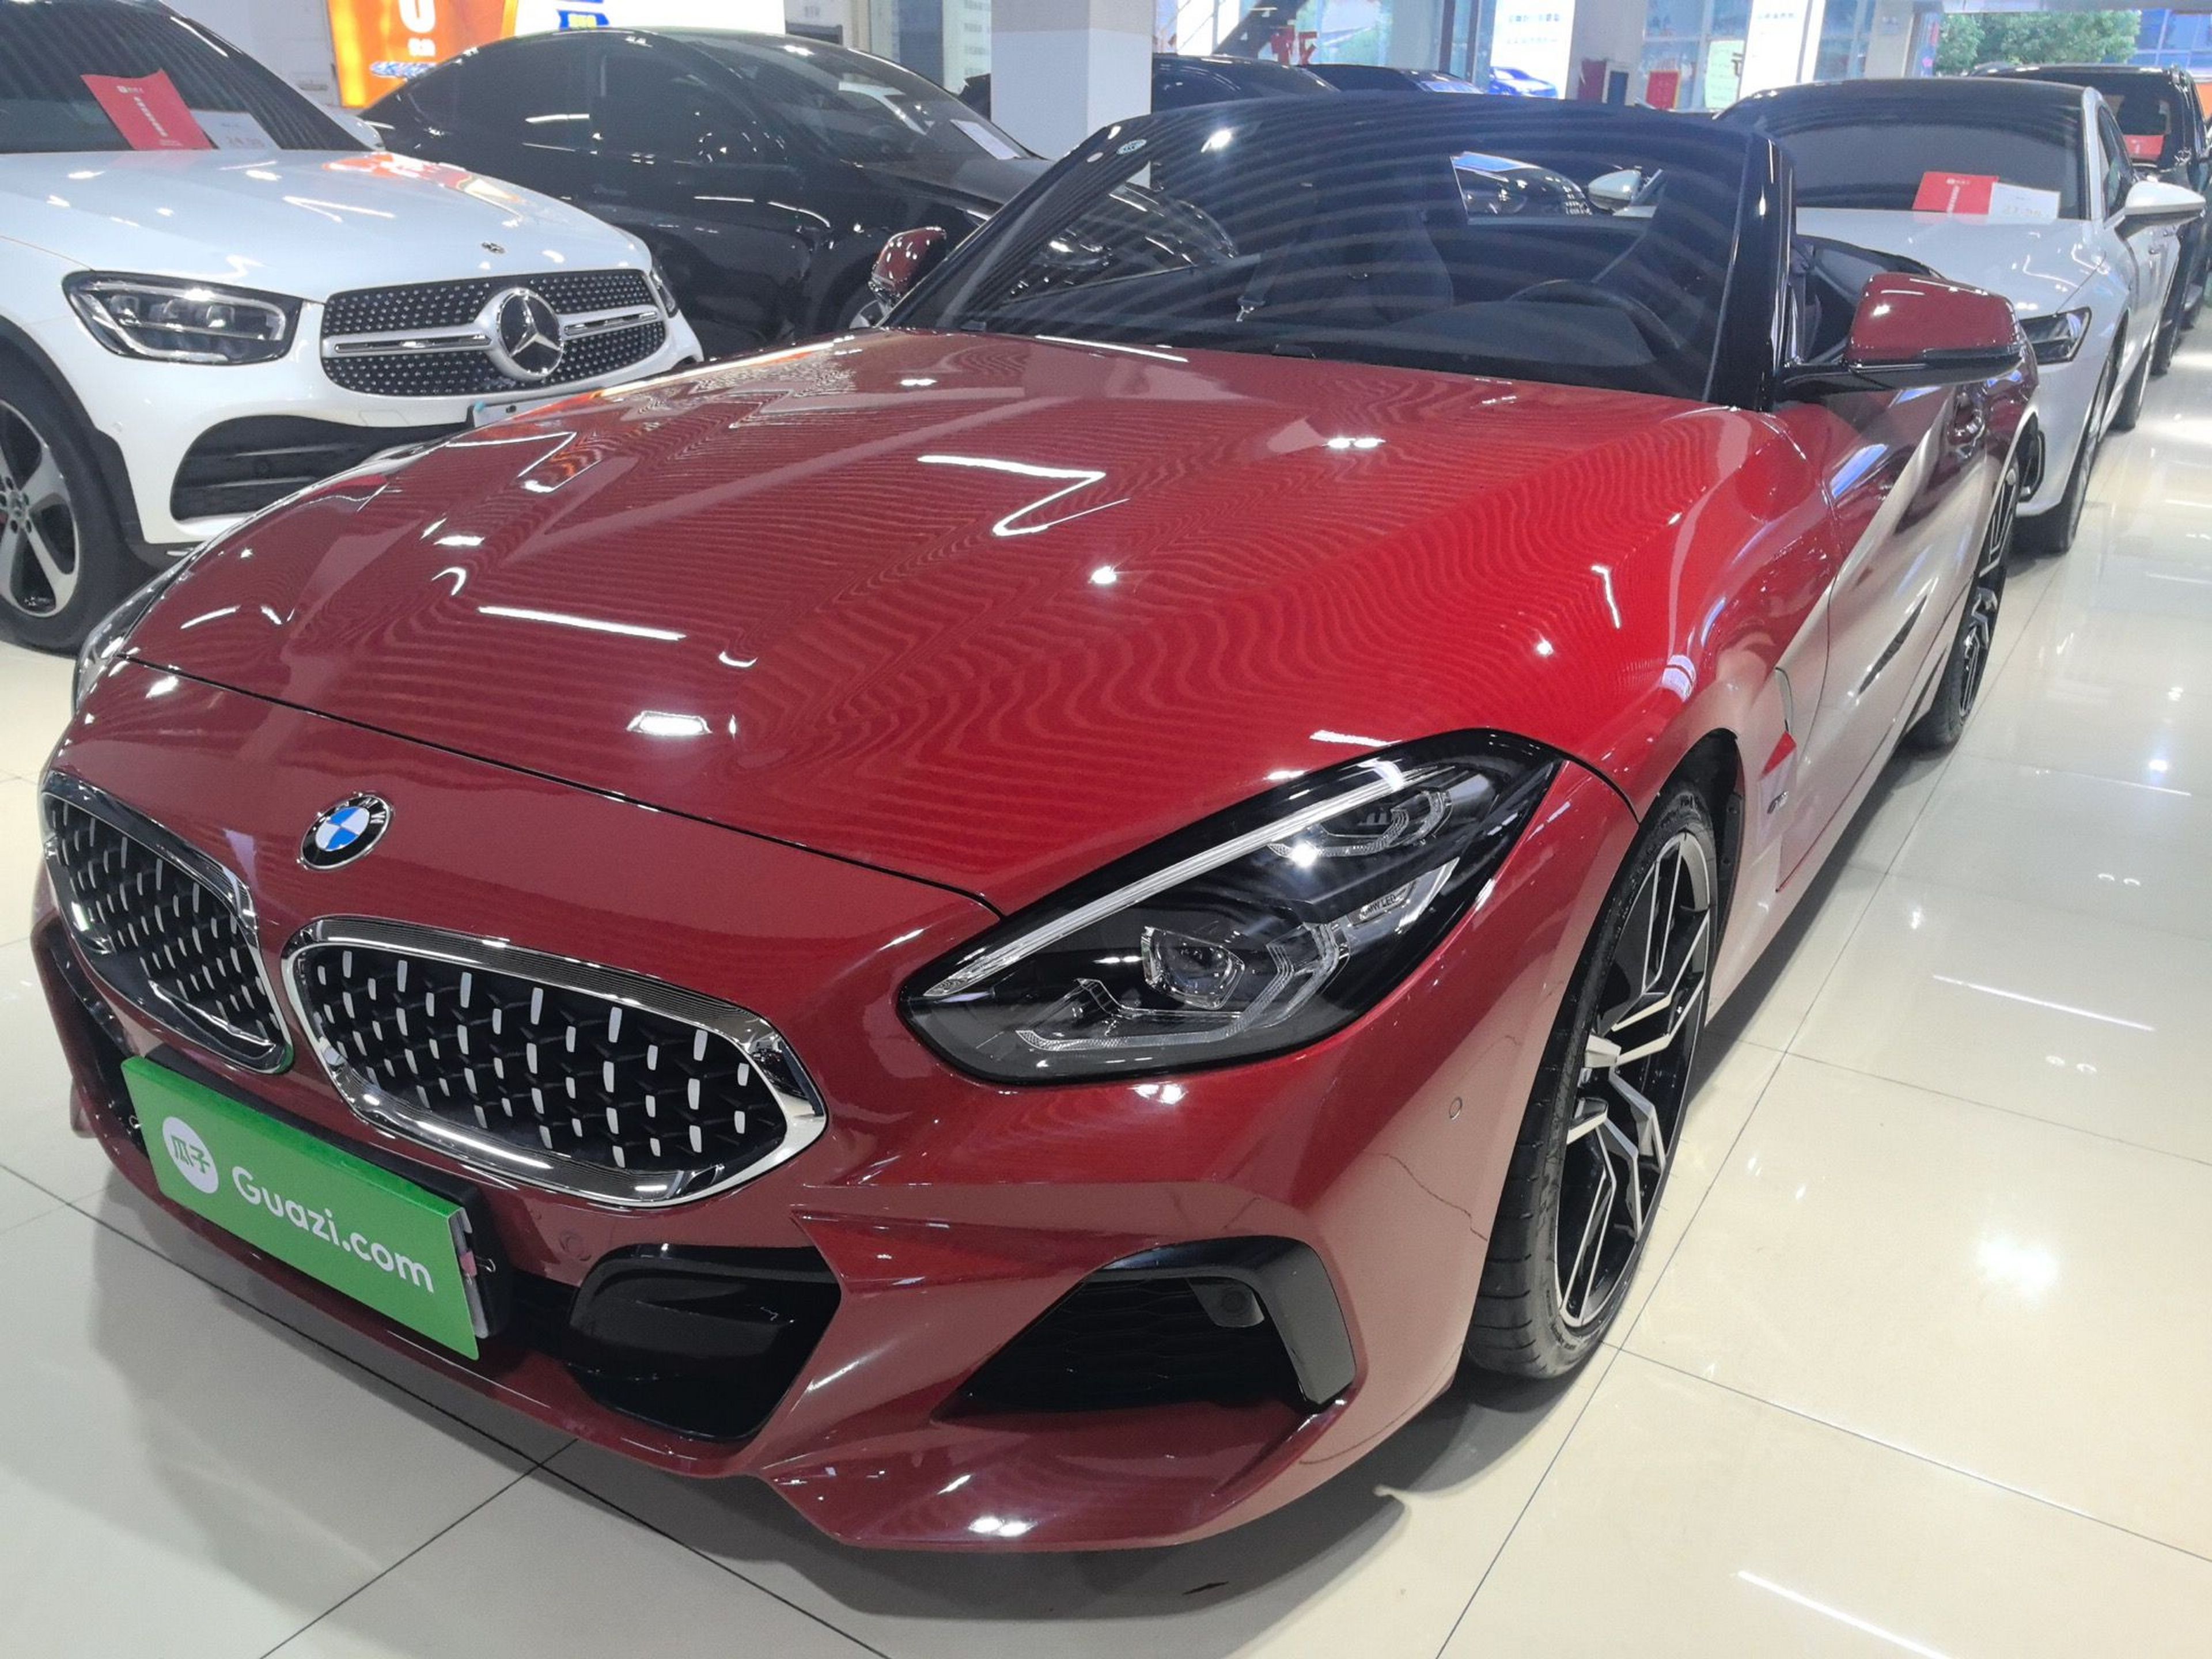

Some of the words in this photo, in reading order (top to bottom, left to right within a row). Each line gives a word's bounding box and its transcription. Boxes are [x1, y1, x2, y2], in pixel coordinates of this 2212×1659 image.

[1381, 893, 1397, 907] LED
[171, 1135, 211, 1174] 瓜子
[231, 1166, 435, 1293] Guazi.com
